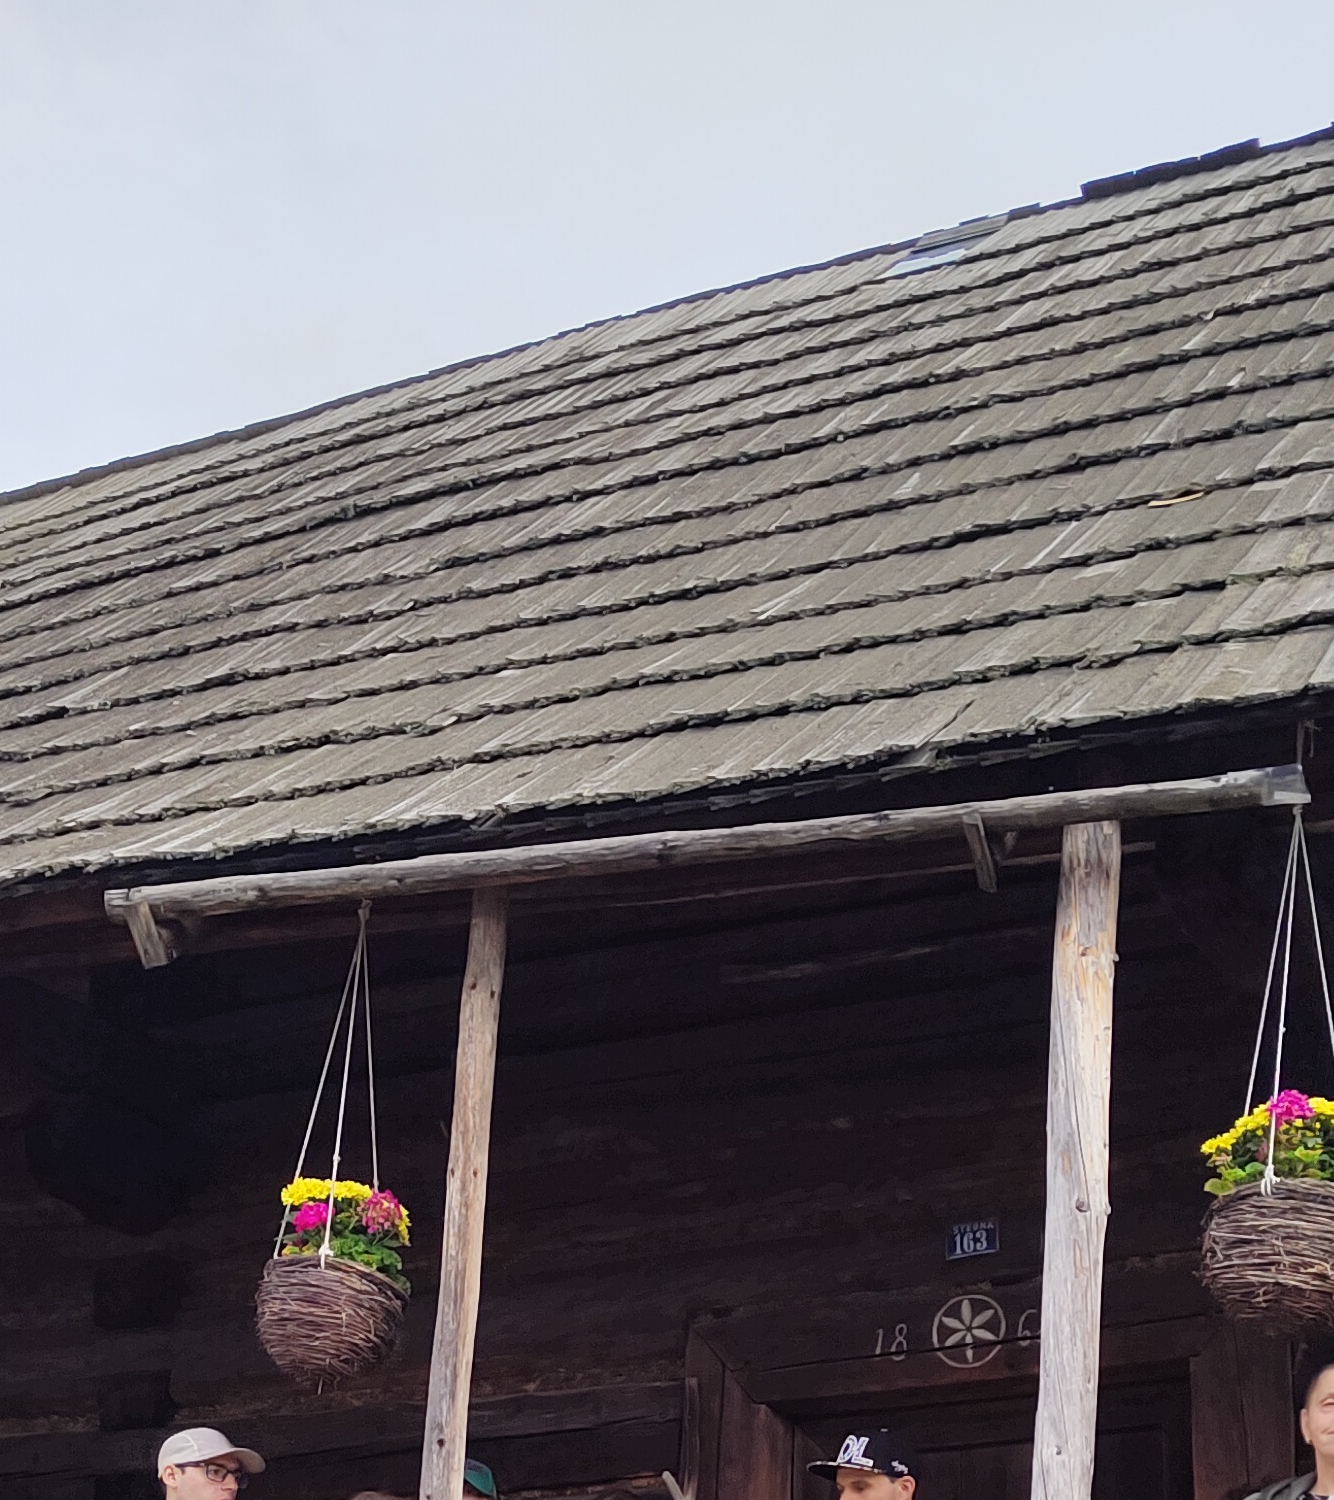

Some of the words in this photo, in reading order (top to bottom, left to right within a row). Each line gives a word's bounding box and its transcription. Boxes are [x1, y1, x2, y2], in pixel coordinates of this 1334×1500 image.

[954, 1229, 987, 1255] 163
[875, 1323, 908, 1361] 18
[1017, 1309, 1041, 1347] 6
